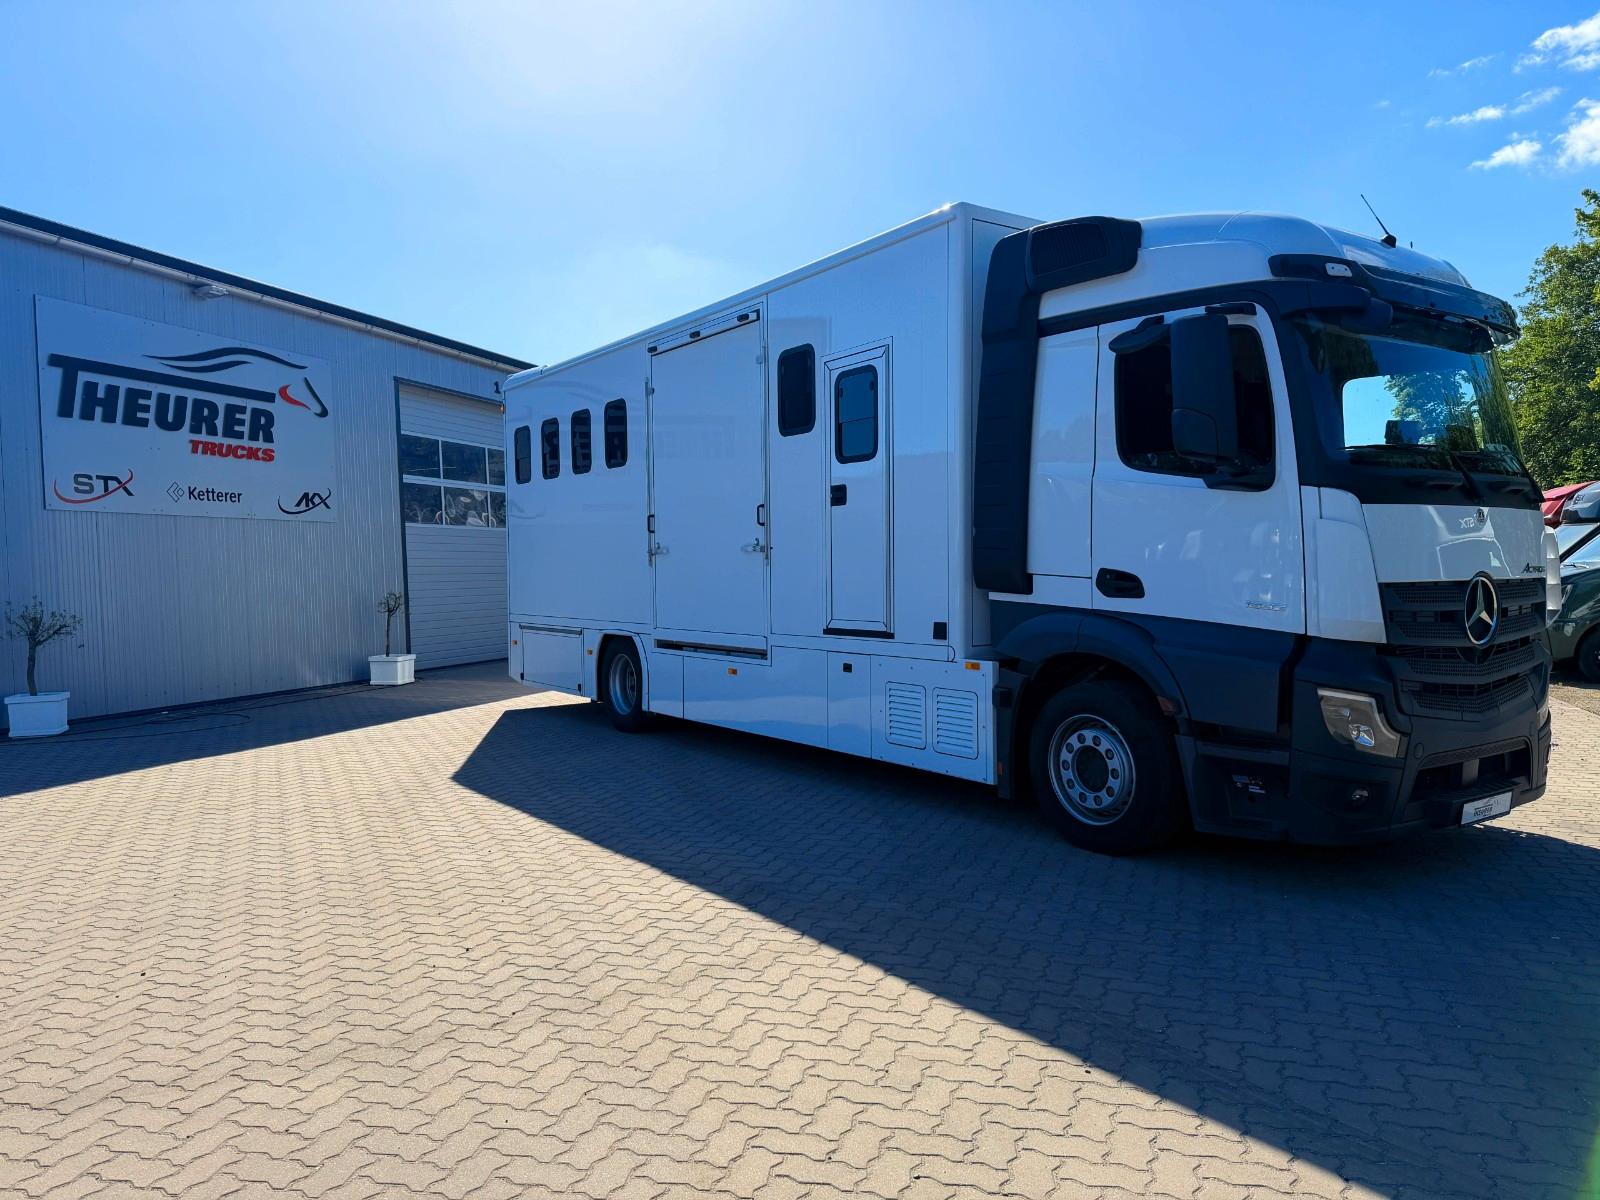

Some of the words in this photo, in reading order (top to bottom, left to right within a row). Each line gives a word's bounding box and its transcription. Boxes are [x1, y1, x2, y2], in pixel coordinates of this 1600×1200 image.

[48, 353, 275, 443] THEURER
[494, 381, 501, 394] 1
[189, 439, 275, 462] TRUCKS
[73, 470, 134, 497] STX
[188, 486, 242, 503] Ketterer
